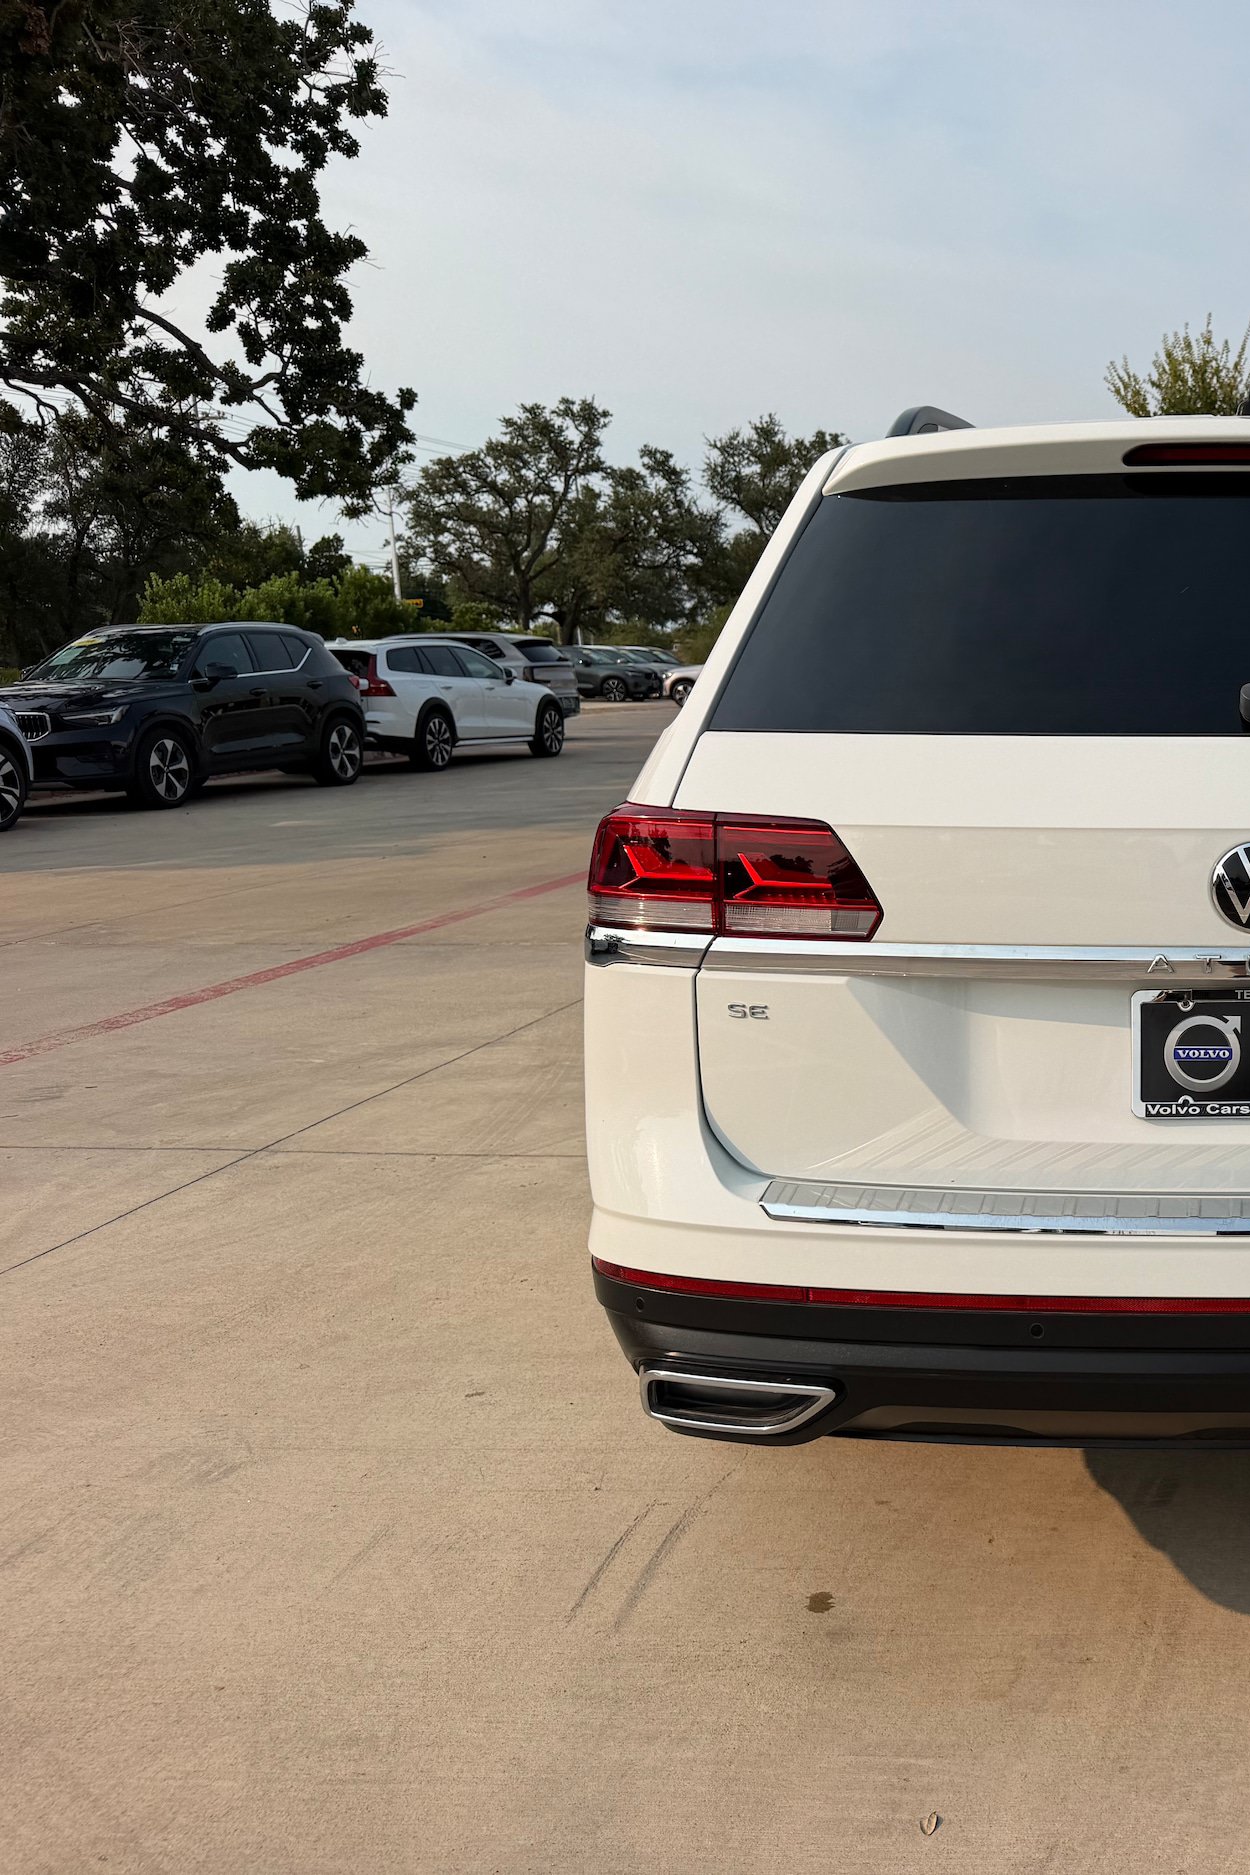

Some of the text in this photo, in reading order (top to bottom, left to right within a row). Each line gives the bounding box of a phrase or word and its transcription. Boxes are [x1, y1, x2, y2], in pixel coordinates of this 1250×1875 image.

[728, 1003, 770, 1020] SE
[1176, 1048, 1231, 1060] VOLVO
[1147, 1103, 1201, 1116] Volvo
[1206, 1103, 1250, 1116] Cars
